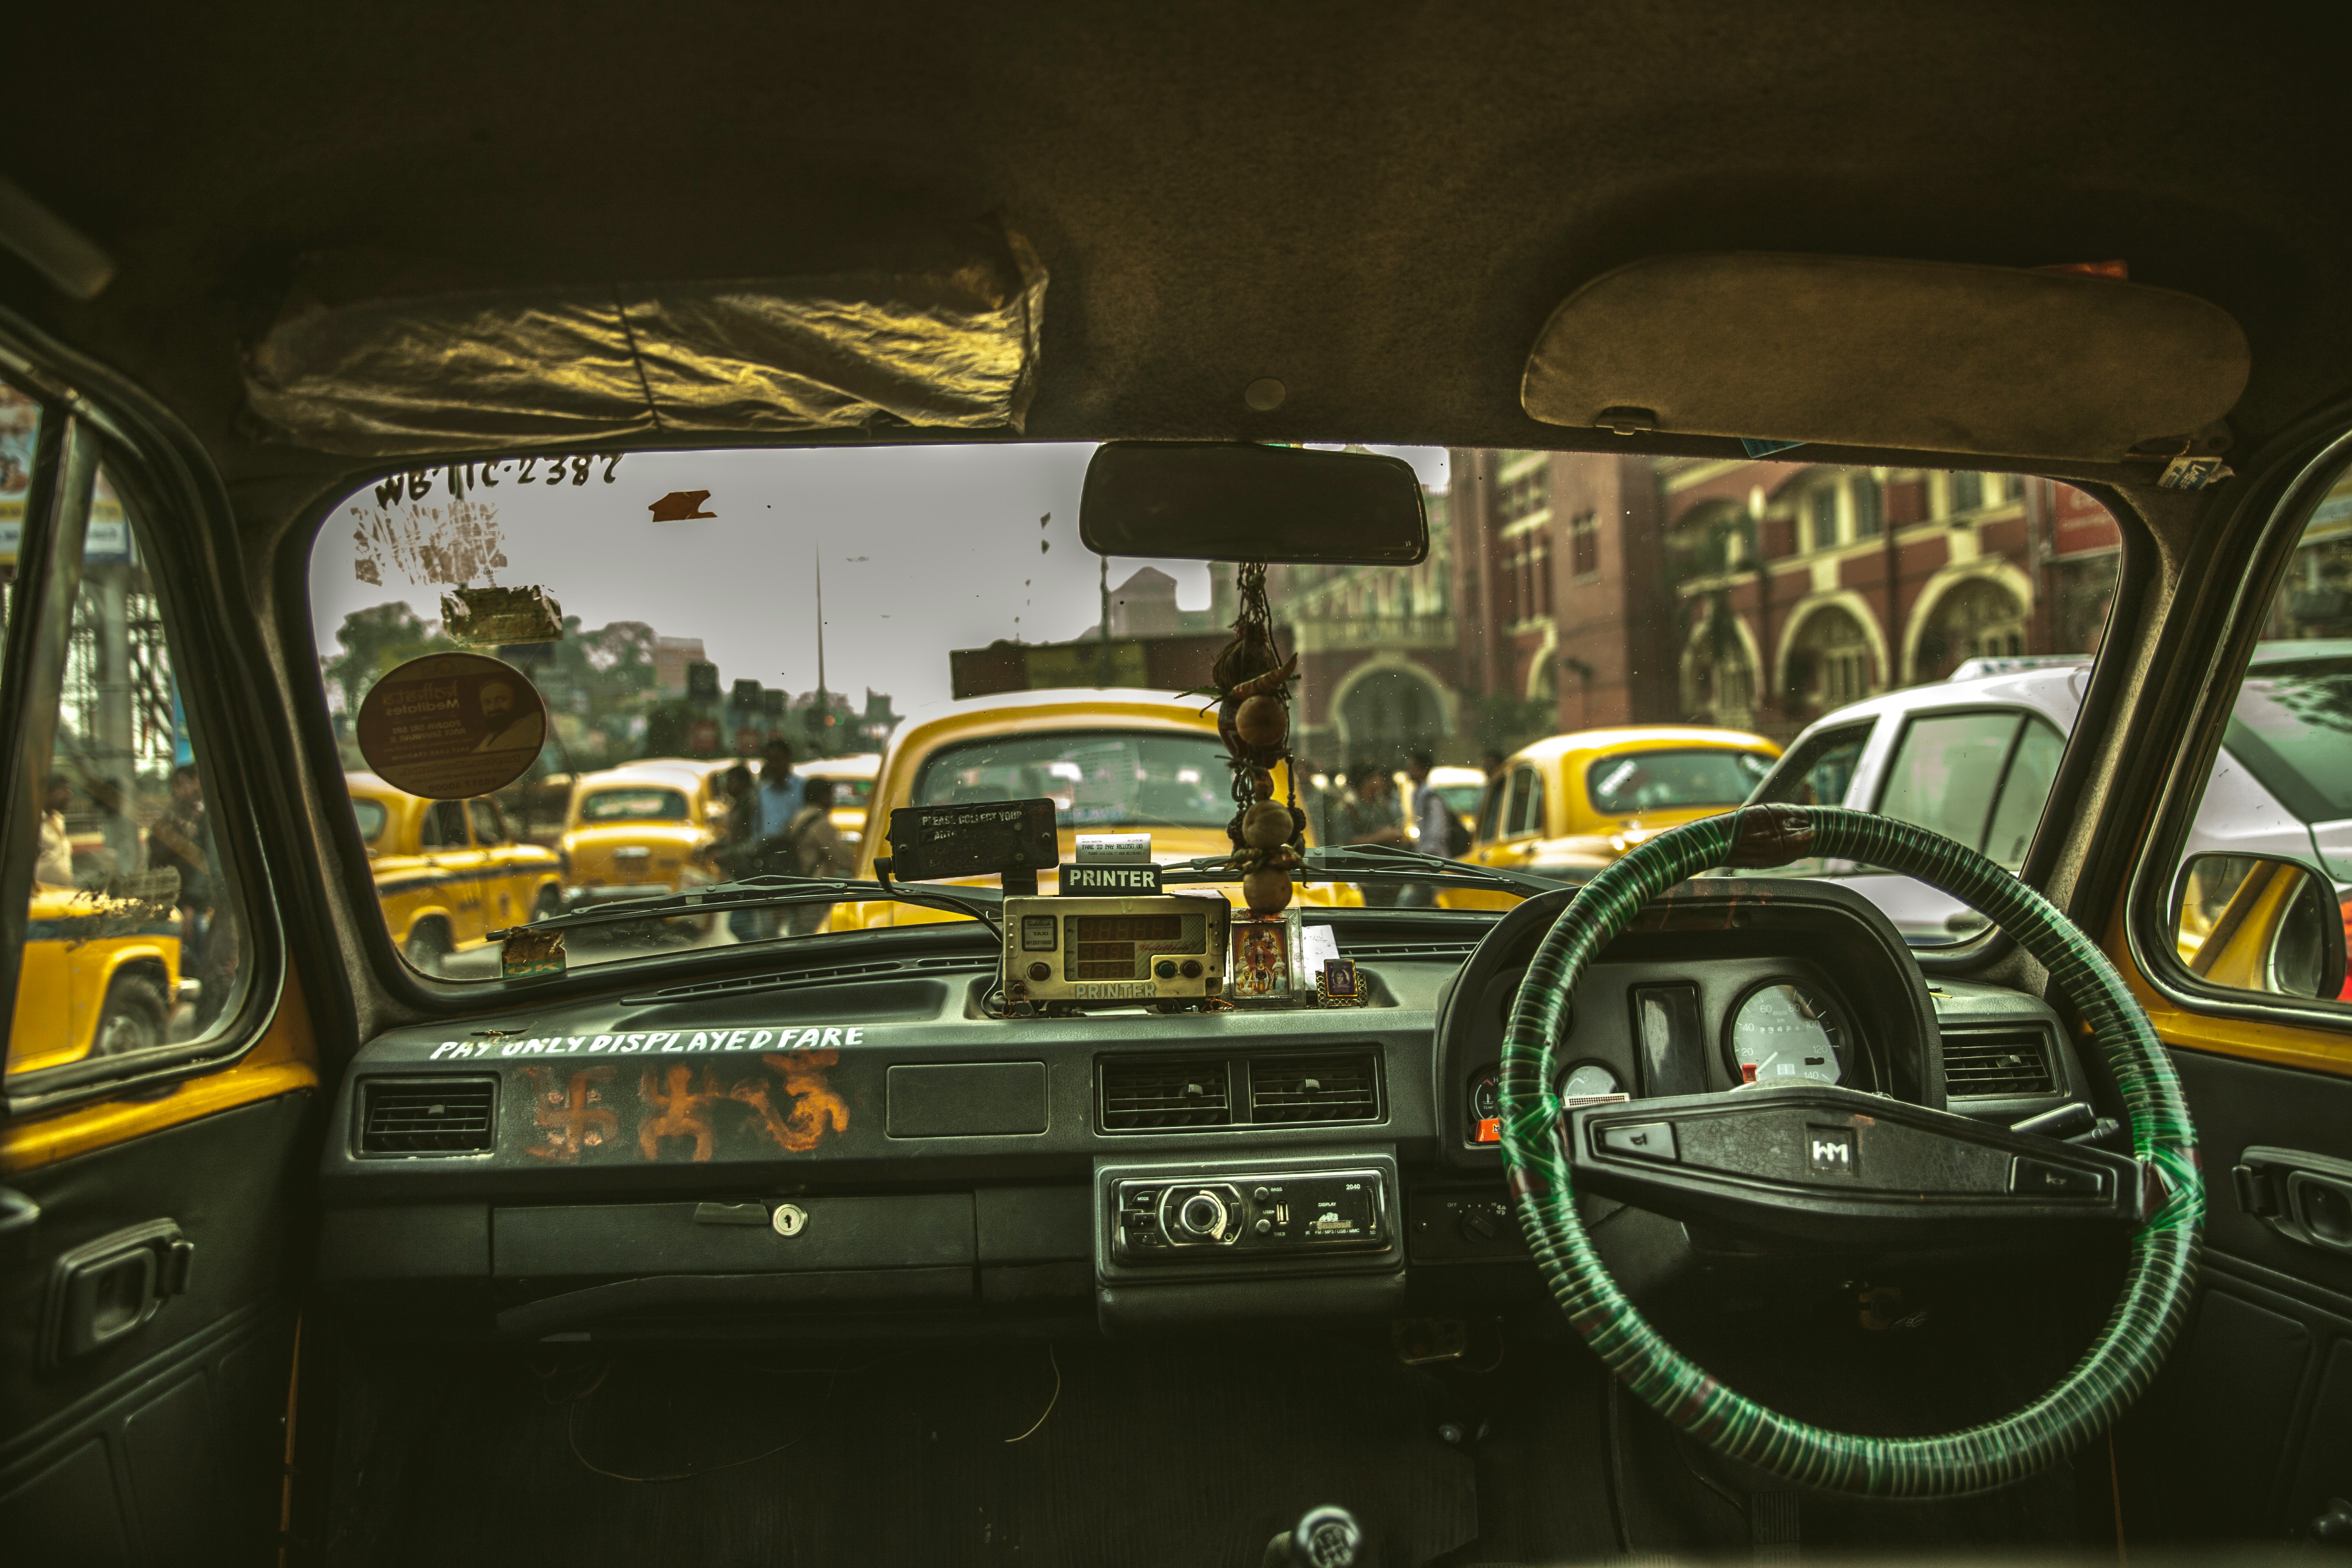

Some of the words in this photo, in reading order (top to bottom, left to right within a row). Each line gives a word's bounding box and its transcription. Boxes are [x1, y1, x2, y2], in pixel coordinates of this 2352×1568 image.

[1070, 870, 1155, 887] PRINTER
[508, 962, 560, 975] OK
[1076, 982, 1155, 999] PRINTER
[1788, 1004, 1800, 1012] 80
[1805, 1020, 1820, 1029] 100
[430, 1041, 491, 1060] PAY
[501, 1036, 585, 1056] ONLY
[589, 1028, 773, 1054] DISPLAYED
[779, 1026, 864, 1049] FARE
[1741, 1047, 1754, 1056] 20
[1813, 1045, 1827, 1053] 120
